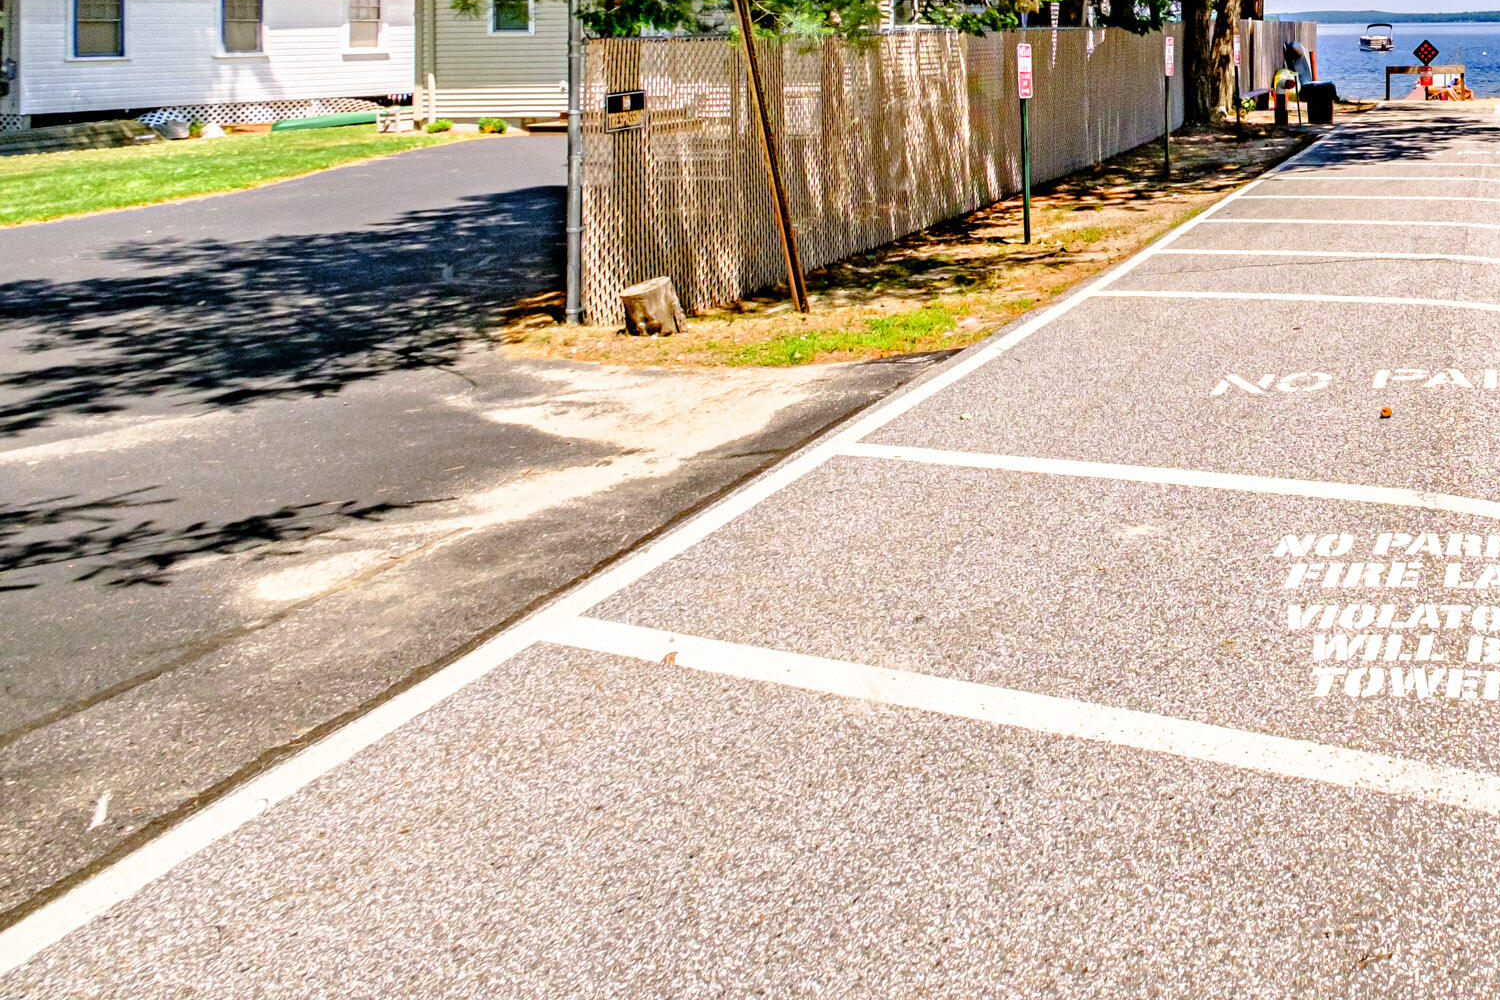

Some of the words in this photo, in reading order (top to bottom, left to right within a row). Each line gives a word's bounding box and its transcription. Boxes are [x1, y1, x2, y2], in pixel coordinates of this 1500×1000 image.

[1210, 371, 1332, 396] NO
[1273, 533, 1355, 558] NO
[1283, 562, 1422, 589] FIRE
[1313, 634, 1448, 662] WILL
